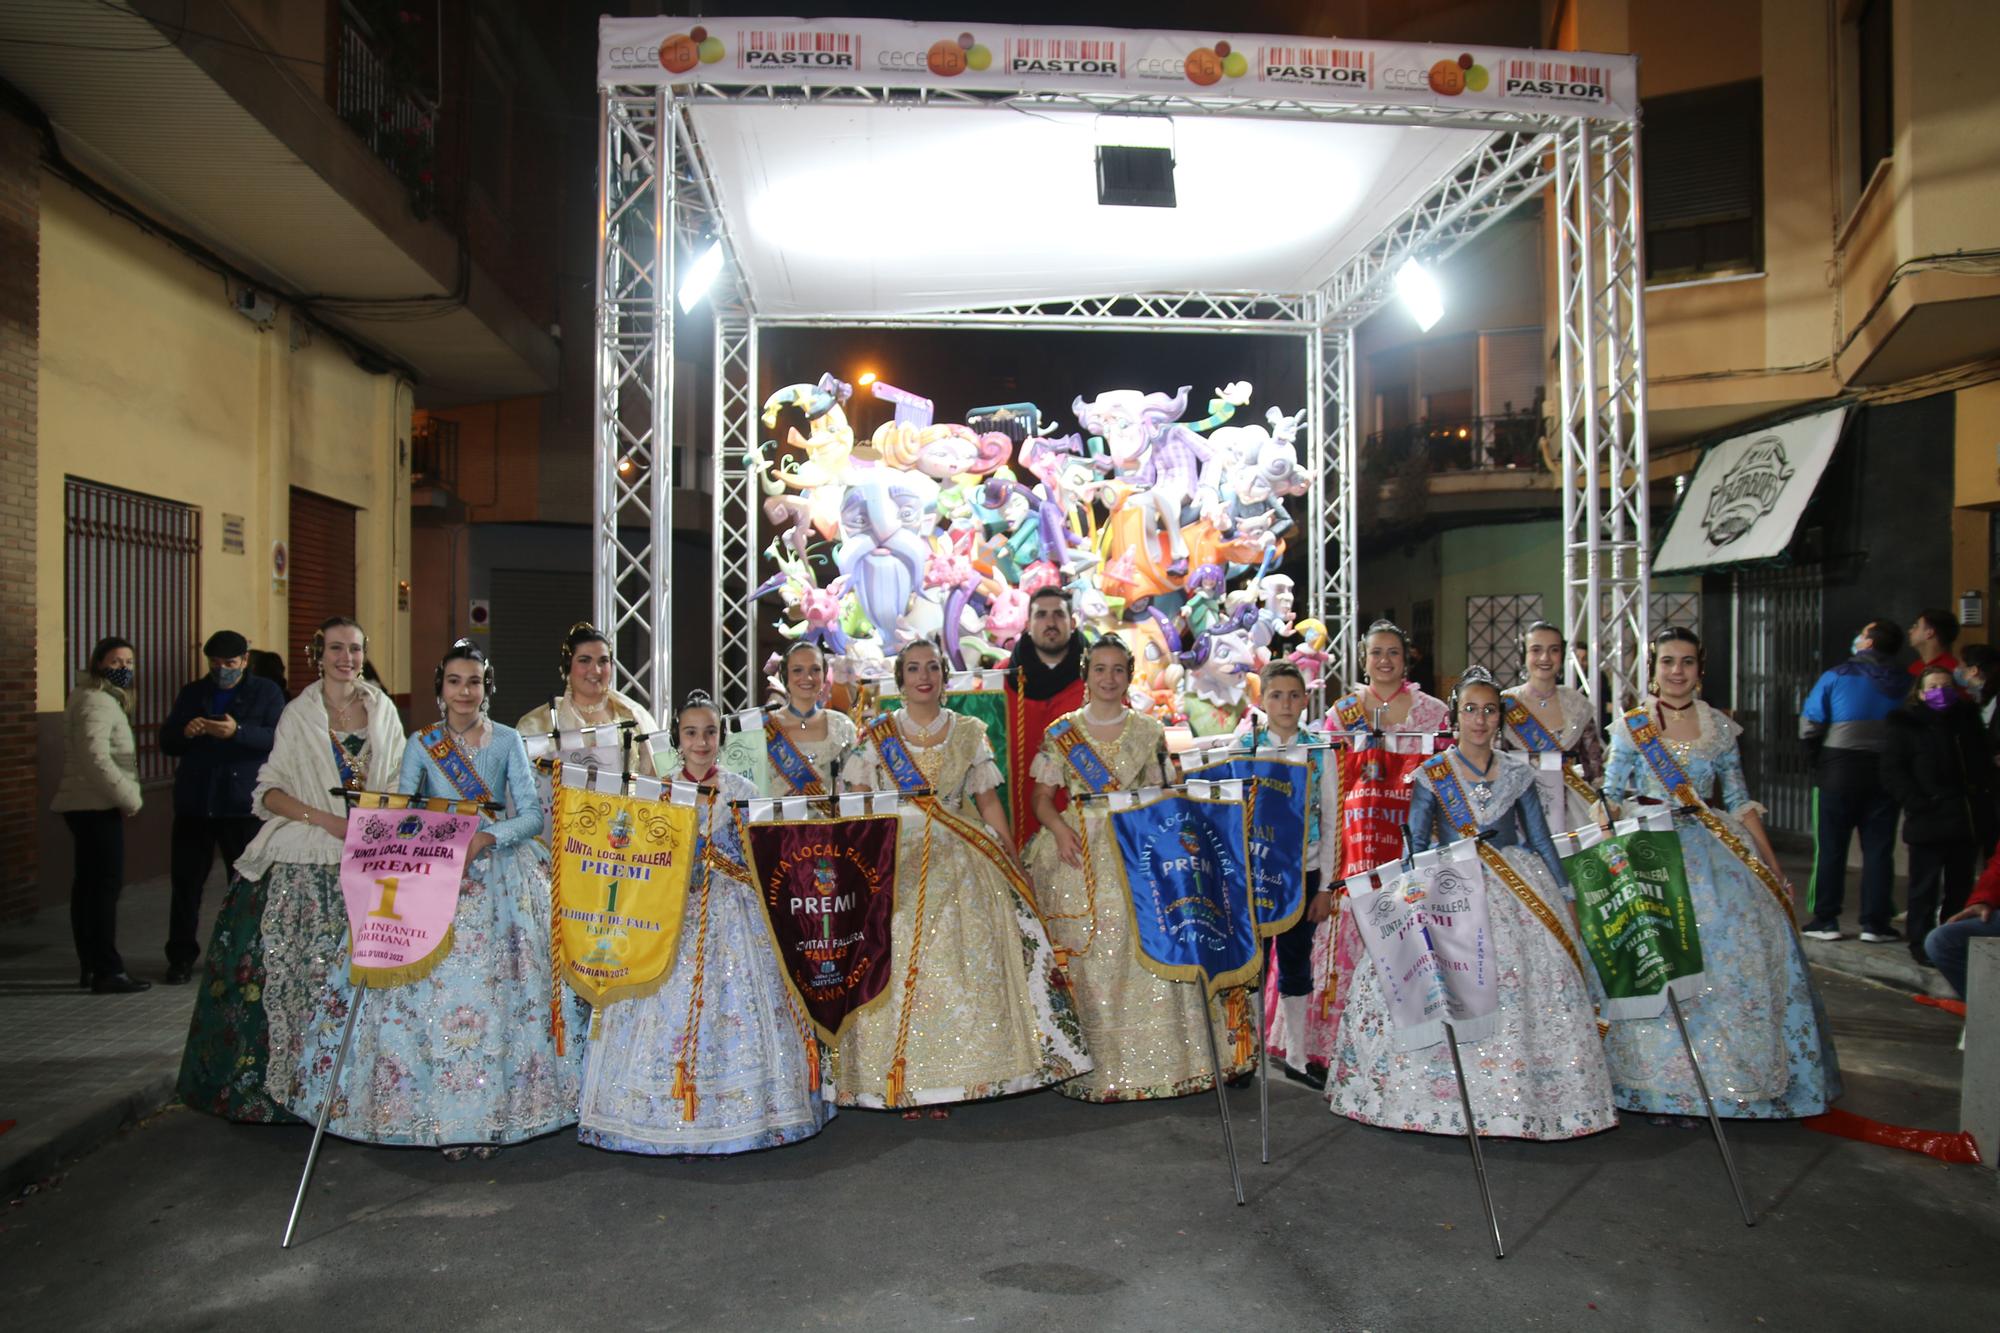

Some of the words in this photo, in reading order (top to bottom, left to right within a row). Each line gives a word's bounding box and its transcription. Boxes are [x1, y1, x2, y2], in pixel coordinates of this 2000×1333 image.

[746, 51, 853, 66] PASTOR
[1013, 59, 1117, 74] PASTOR
[1266, 66, 1367, 83] PASTOR
[1506, 79, 1605, 98] PASTOR
[1354, 787, 1382, 799] LOCAL
[1384, 788, 1412, 800] FALLE
[1158, 811, 1196, 833] LOCA
[1344, 806, 1405, 830] PREMI
[352, 848, 378, 860] JUNTA
[379, 844, 408, 856] LOCAL
[412, 846, 454, 860] FALLERA
[564, 835, 593, 857] JUNTA
[597, 849, 626, 862] LOCAL
[632, 850, 672, 867] FALLERA
[791, 843, 841, 862] LOCAL
[1364, 843, 1377, 854] de
[361, 860, 432, 875] PREMI
[581, 859, 651, 881] PREMI
[1193, 871, 1203, 894] 1
[1584, 887, 1610, 907] JUNTA
[1633, 866, 1670, 881] FALLERA
[367, 877, 402, 921] 1
[606, 880, 619, 913] 1
[790, 891, 856, 916] PREMI
[1598, 882, 1664, 921] PREMI
[608, 914, 624, 926] DE
[626, 916, 661, 931] FALLA
[821, 913, 831, 940] 1
[1380, 918, 1403, 940] JUNTA
[1431, 897, 1472, 913] FALLERA
[371, 922, 429, 939] INFANTIL
[1419, 925, 1435, 952] 1
[570, 959, 609, 978] BURRIANA
[610, 967, 631, 979] 2022
